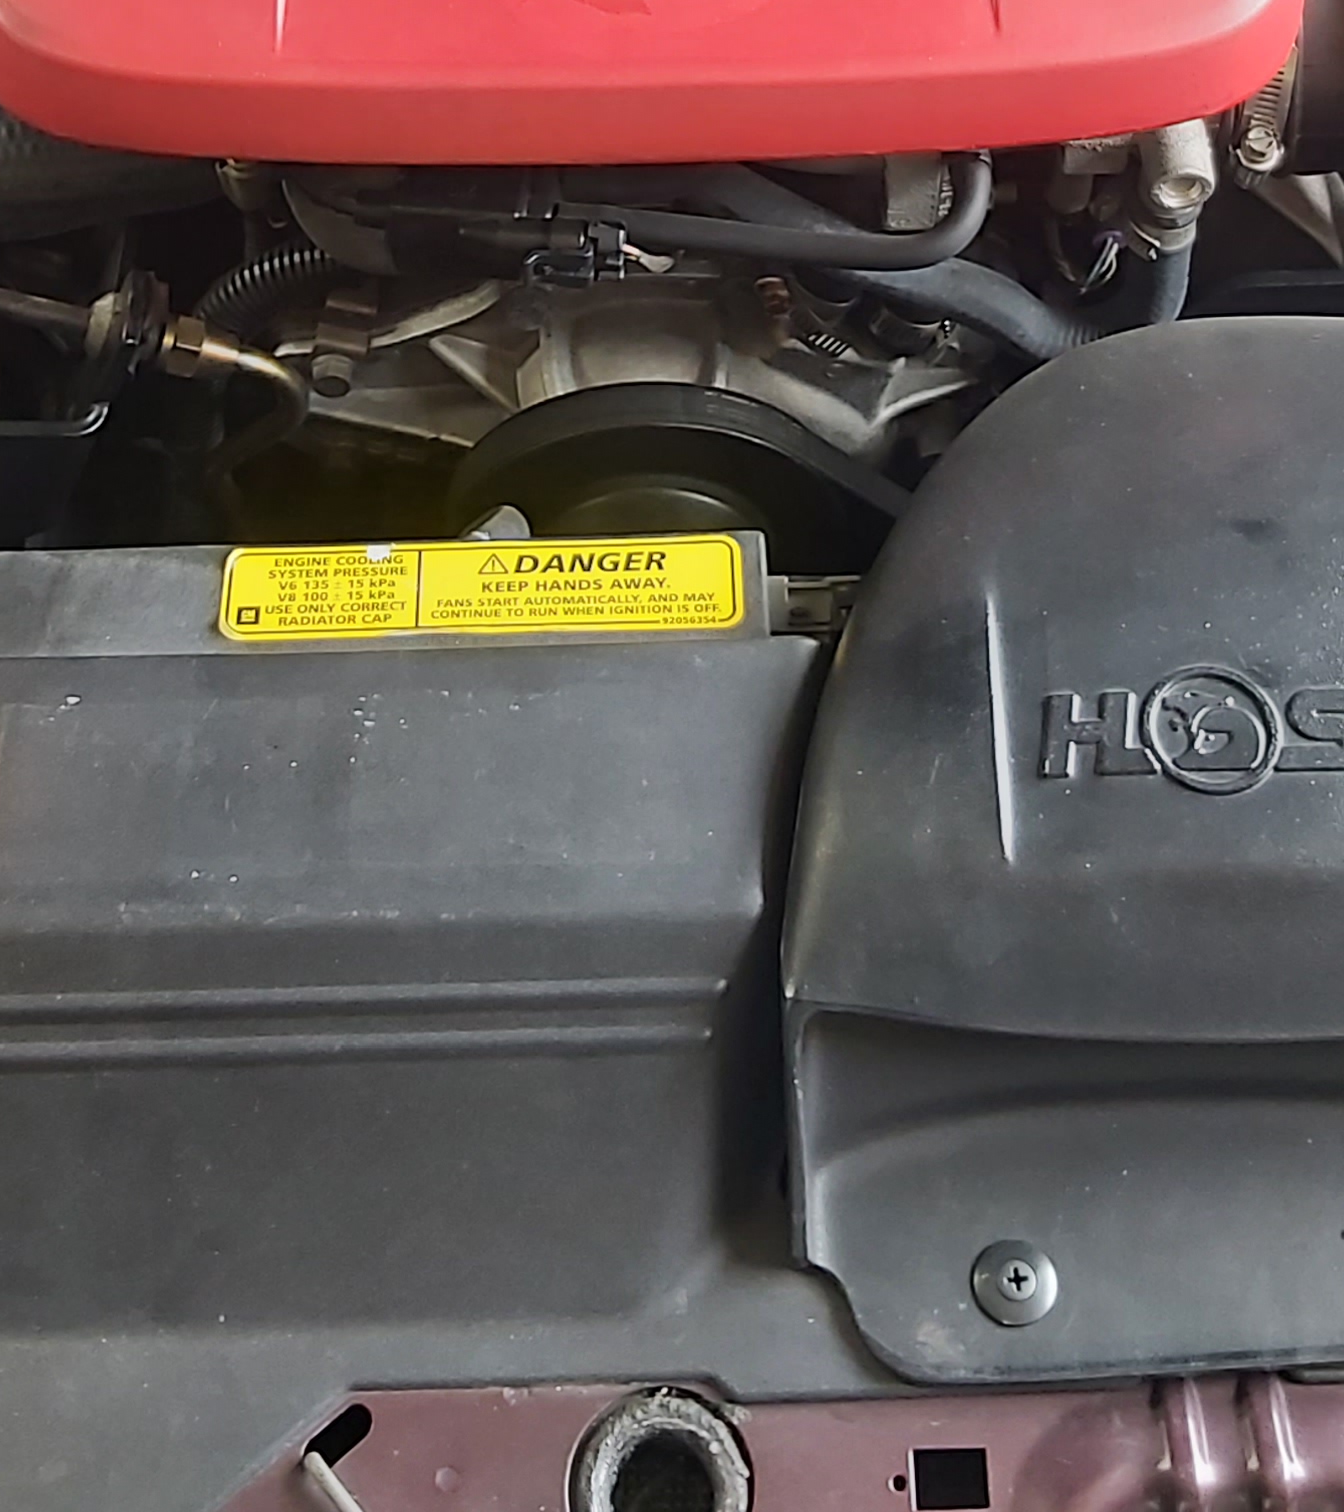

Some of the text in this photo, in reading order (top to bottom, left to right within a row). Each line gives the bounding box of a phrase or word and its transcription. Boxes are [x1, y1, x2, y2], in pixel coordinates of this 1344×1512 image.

[274, 557, 331, 567] ENGINE
[514, 551, 667, 574] DANGER
[268, 566, 408, 579] SYSTEM PRESSURE
[279, 581, 297, 590] V6
[304, 580, 329, 590] 135
[348, 579, 364, 589] 15
[369, 578, 396, 587] kPa
[481, 577, 671, 593] KEEP HANDS AWAY.
[278, 592, 296, 602] V8
[304, 591, 328, 601] 100
[347, 591, 363, 600] 15
[368, 589, 395, 600] kPa
[437, 591, 715, 607] FANS START AUTOMATICALLY, AND MAY
[265, 601, 407, 614] USE ONLY CORRECT
[431, 603, 722, 619] CONTINUE TO RUN WHEN IGNITION IS OFF.
[278, 613, 392, 626] RADIATOR CAP
